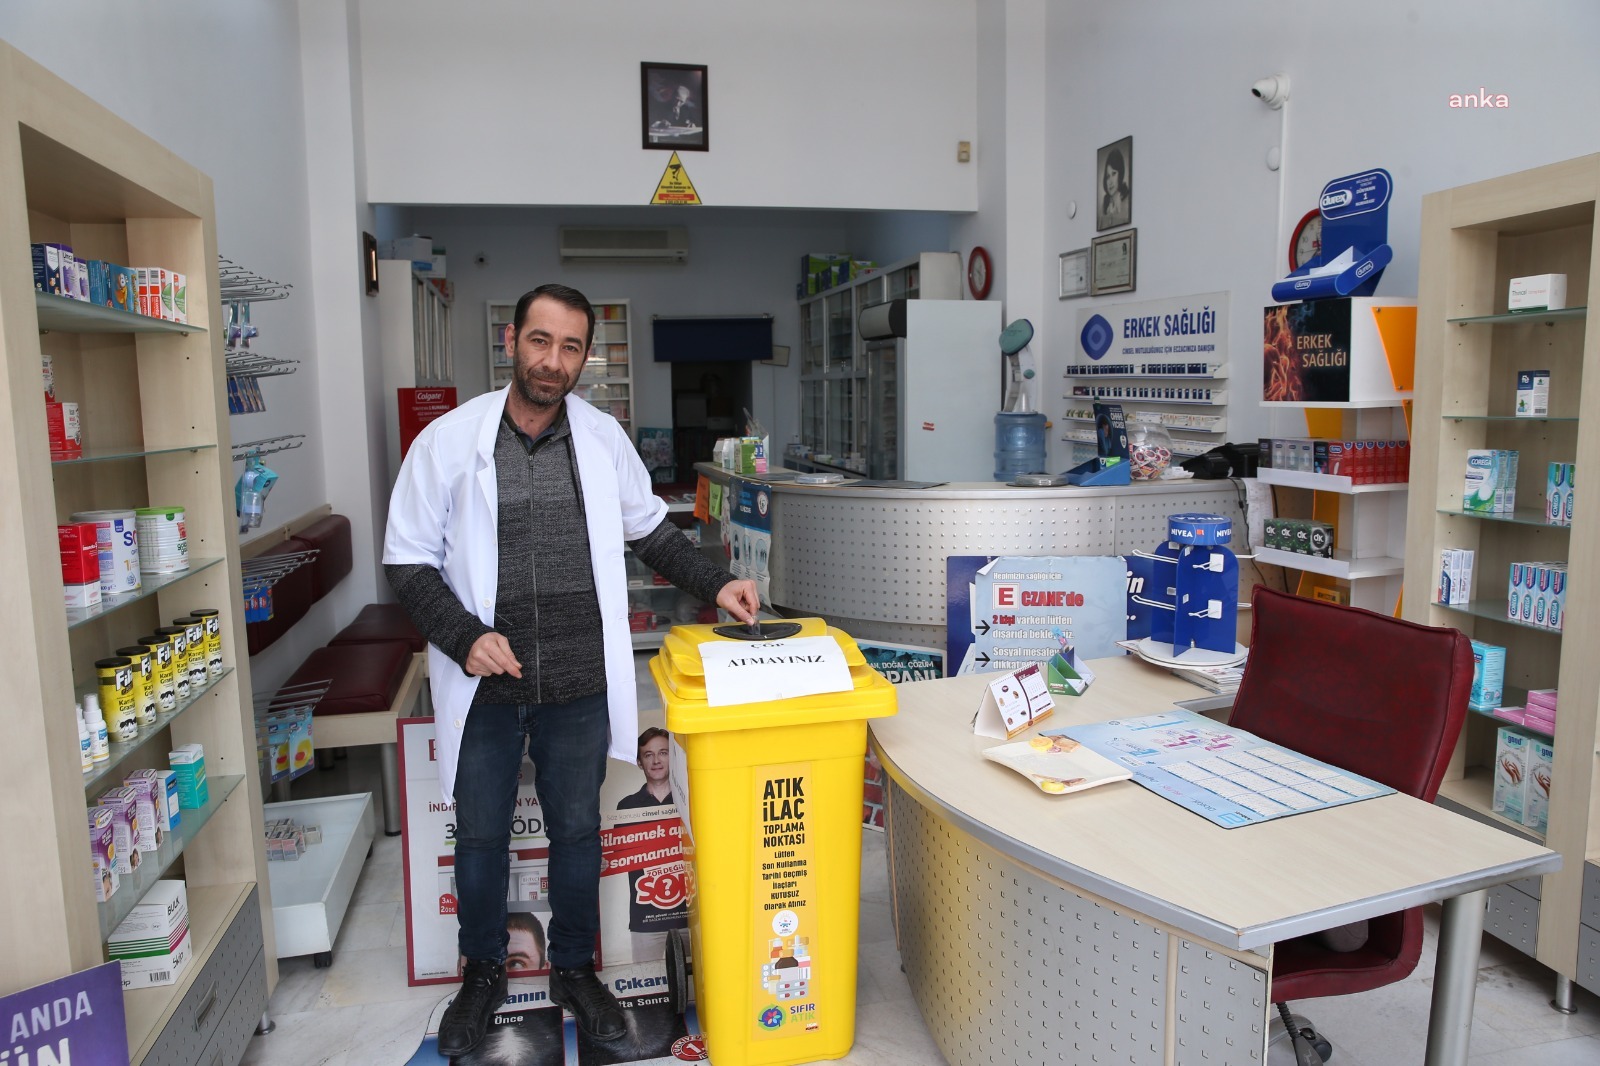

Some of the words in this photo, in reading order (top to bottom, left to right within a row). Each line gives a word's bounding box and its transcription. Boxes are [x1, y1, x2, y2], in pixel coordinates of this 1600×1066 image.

[1322, 193, 1346, 206] durex
[1123, 316, 1160, 338] ERKEK
[1164, 306, 1216, 336] SAĞLIĞI
[1296, 334, 1332, 350] ERKEK
[1302, 350, 1346, 368] SAĞLIĞI
[417, 392, 442, 402] Colgate
[1171, 528, 1193, 538] NIVEA
[993, 572, 1025, 581] Hepimizin
[992, 615, 998, 624] 2
[1016, 616, 1046, 625] varken
[1047, 614, 1072, 625] lütfen
[992, 630, 1028, 641] dışarıda
[992, 647, 1022, 657] Sosyal
[728, 655, 825, 668] ATMAYINIZ
[882, 660, 906, 669] DOĞAL
[908, 660, 934, 670] ÇÖZÜM
[992, 660, 1020, 670] dikkat
[763, 776, 804, 800] ATIK
[642, 807, 660, 817] cinsel
[763, 798, 804, 822] İLAÇ
[764, 822, 804, 835] TOPLAMA
[763, 833, 805, 848] NOKTASI
[774, 850, 795, 858] Lütfen
[762, 862, 774, 870] Son
[776, 860, 806, 868] Kullanma
[762, 872, 782, 880] Tarihi
[783, 869, 808, 879] Geçmiş
[770, 890, 800, 900] KUTUSUZ
[168, 896, 180, 916] BULK
[764, 902, 787, 910] Olarak
[788, 899, 806, 908] Atınız
[637, 995, 670, 1006] Sonra
[790, 1003, 815, 1014] SIFIR
[10, 990, 93, 1044] ANDA
[494, 1014, 524, 1026] Önce
[791, 1012, 815, 1024] ATIK
